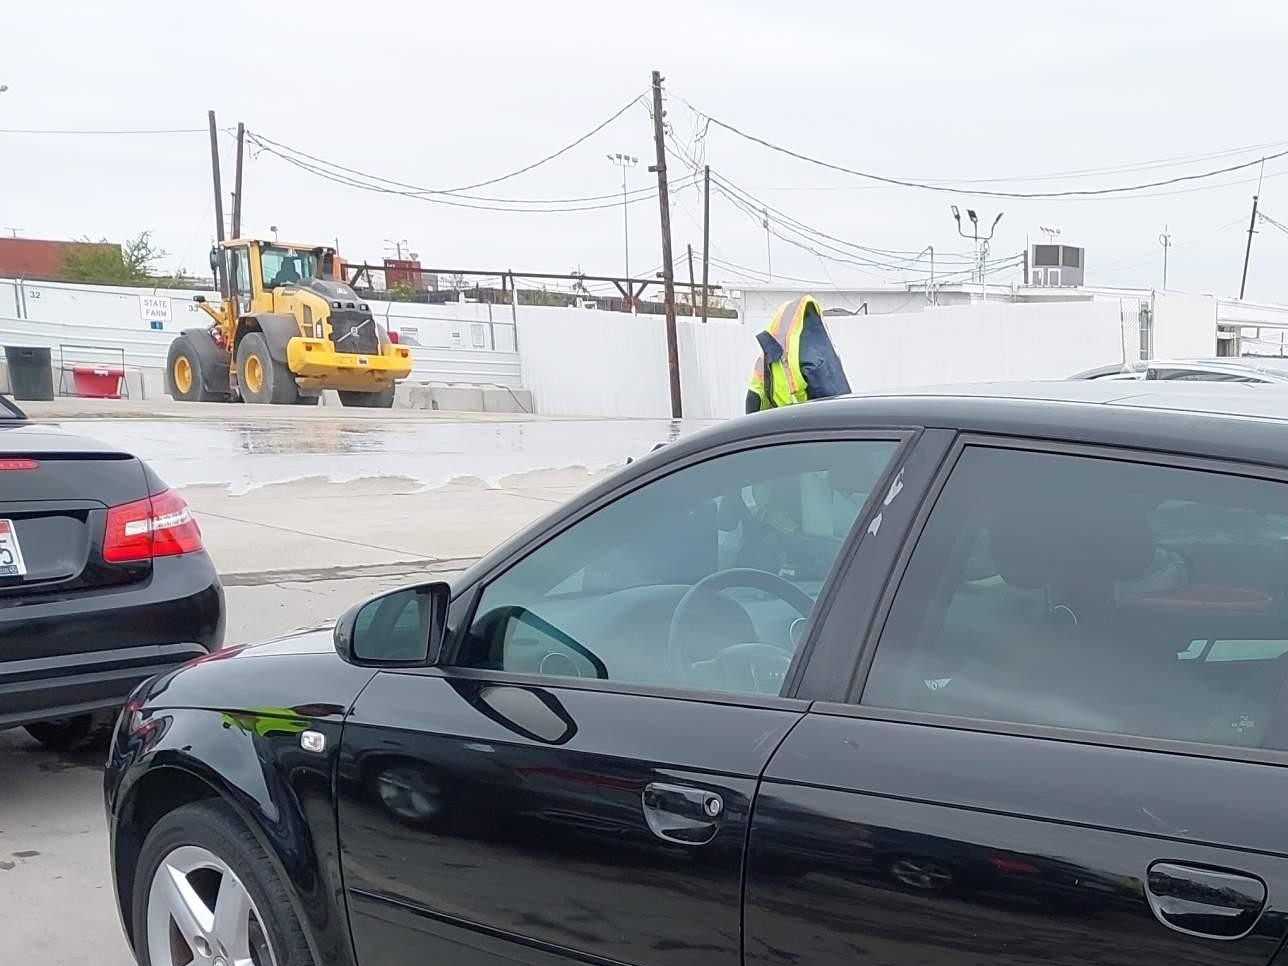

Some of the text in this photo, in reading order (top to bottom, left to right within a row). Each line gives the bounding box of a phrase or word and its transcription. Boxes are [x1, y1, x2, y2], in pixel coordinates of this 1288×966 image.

[29, 290, 41, 299] 32
[143, 299, 168, 308] STATE
[188, 304, 199, 312] 33
[145, 309, 167, 317] FARM
